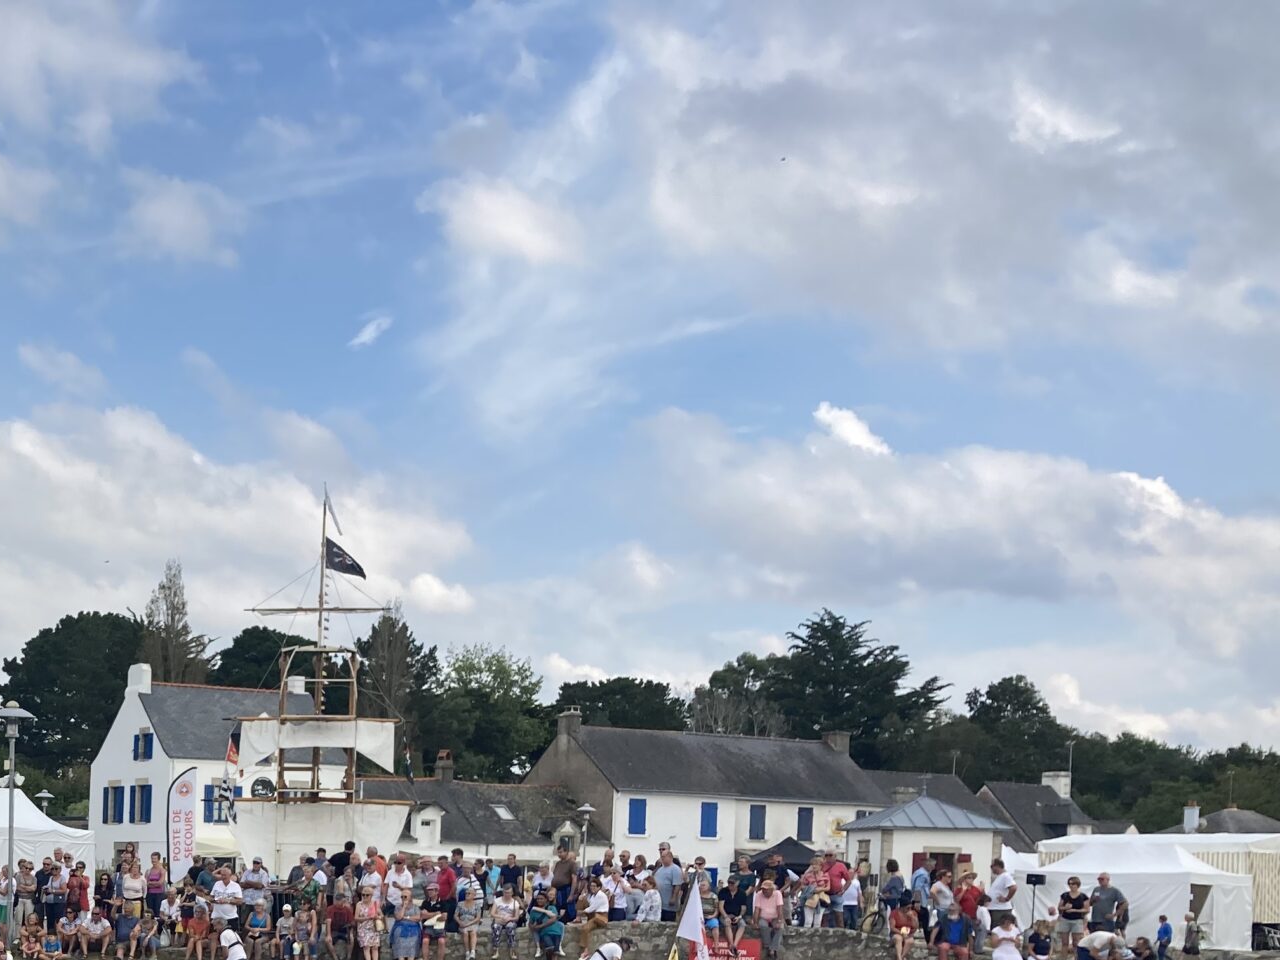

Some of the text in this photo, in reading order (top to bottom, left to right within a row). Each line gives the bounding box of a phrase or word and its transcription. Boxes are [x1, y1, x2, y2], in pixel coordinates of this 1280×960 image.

[173, 808, 181, 862] POSTE DE
[184, 810, 193, 859] SECOURS
